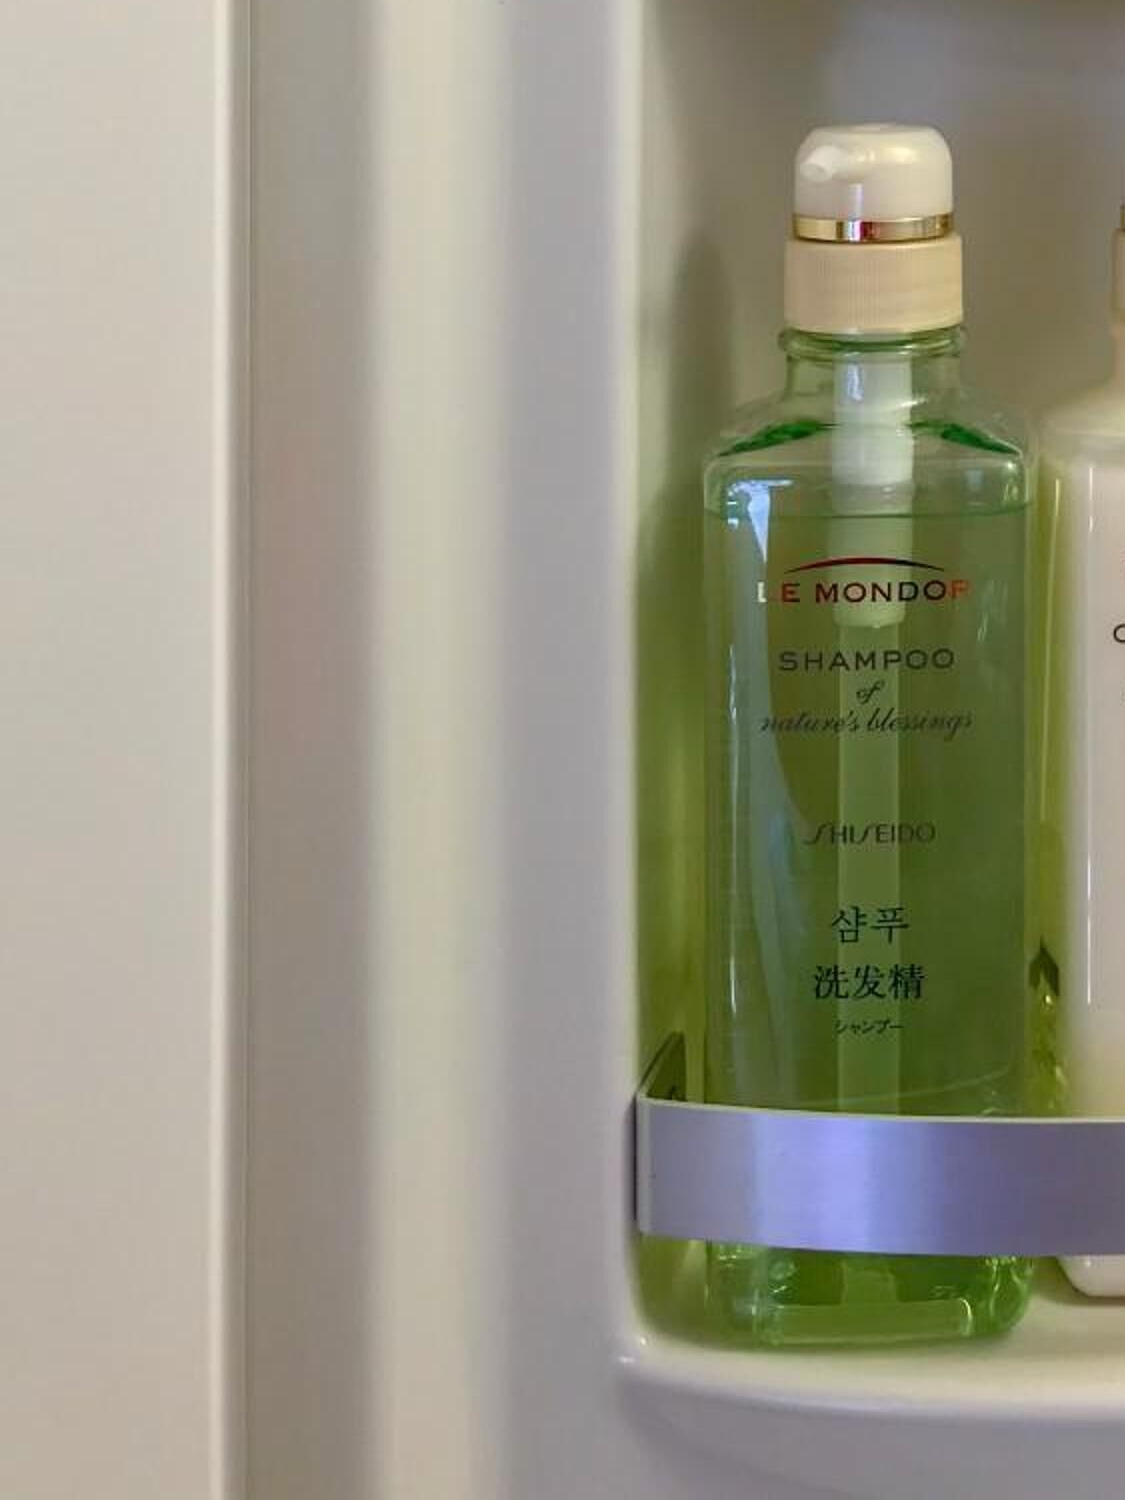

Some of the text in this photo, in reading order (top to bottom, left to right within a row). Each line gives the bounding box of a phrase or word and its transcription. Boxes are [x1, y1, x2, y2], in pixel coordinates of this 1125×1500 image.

[757, 581, 801, 604] LE
[777, 649, 956, 672] SHAMPOO
[855, 679, 885, 705] of
[760, 706, 974, 743] nature's blessings
[803, 822, 936, 845] SHISEIDO
[831, 905, 910, 944] 샴푸
[813, 964, 926, 1000] 洗发精
[834, 1018, 904, 1035] シャンプー
